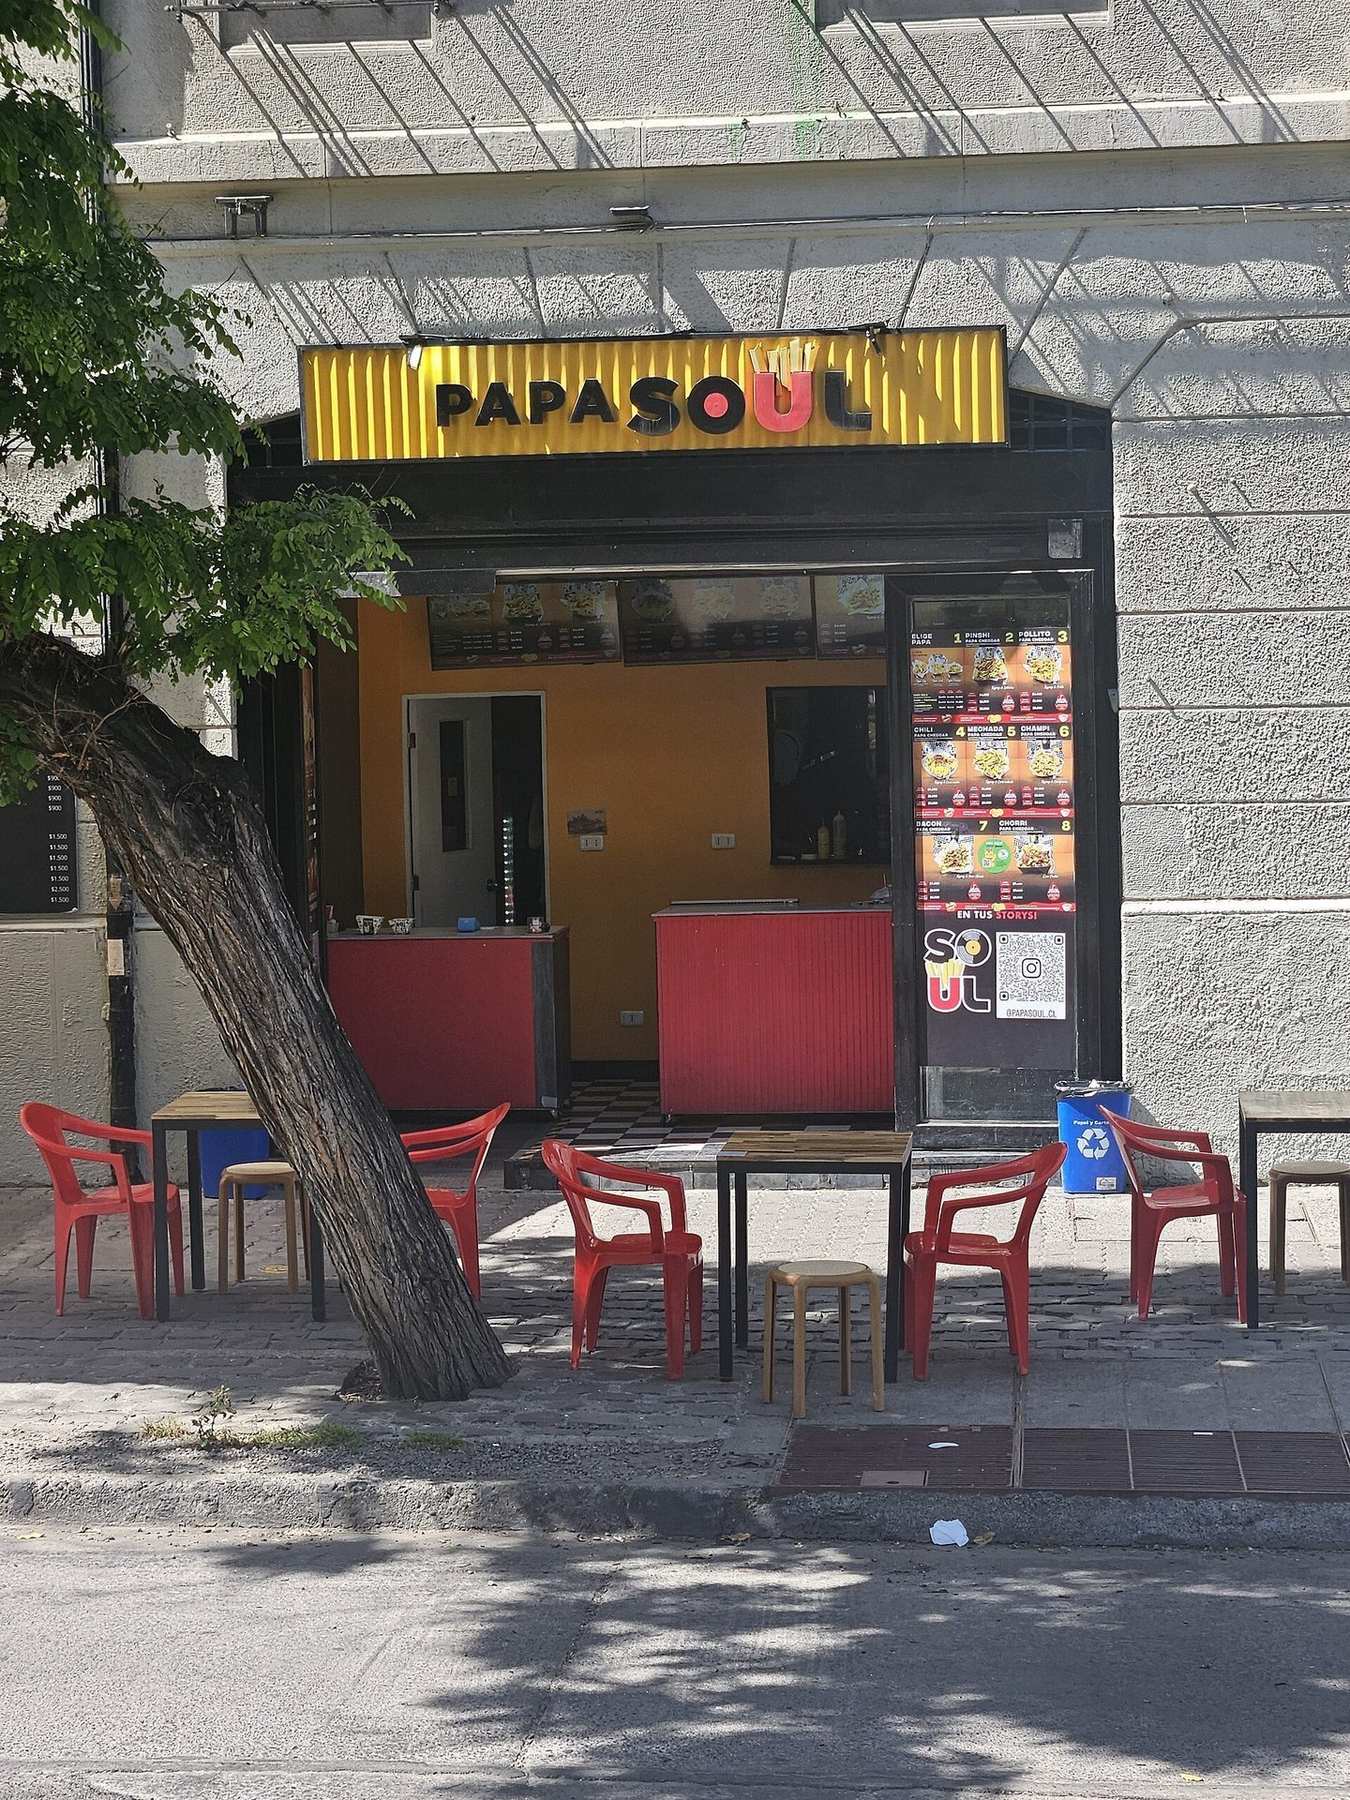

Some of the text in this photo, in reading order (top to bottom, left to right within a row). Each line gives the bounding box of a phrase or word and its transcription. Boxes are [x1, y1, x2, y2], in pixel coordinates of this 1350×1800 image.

[953, 633, 962, 644] 1
[1005, 632, 1014, 643] 2
[1057, 630, 1068, 643] 3
[955, 726, 966, 737] 4
[1007, 726, 1016, 737] 5
[1059, 725, 1070, 738] 6
[979, 820, 988, 832] 7
[1061, 820, 1071, 832] 8
[957, 910, 971, 919] EN
[974, 910, 993, 919] TUS
